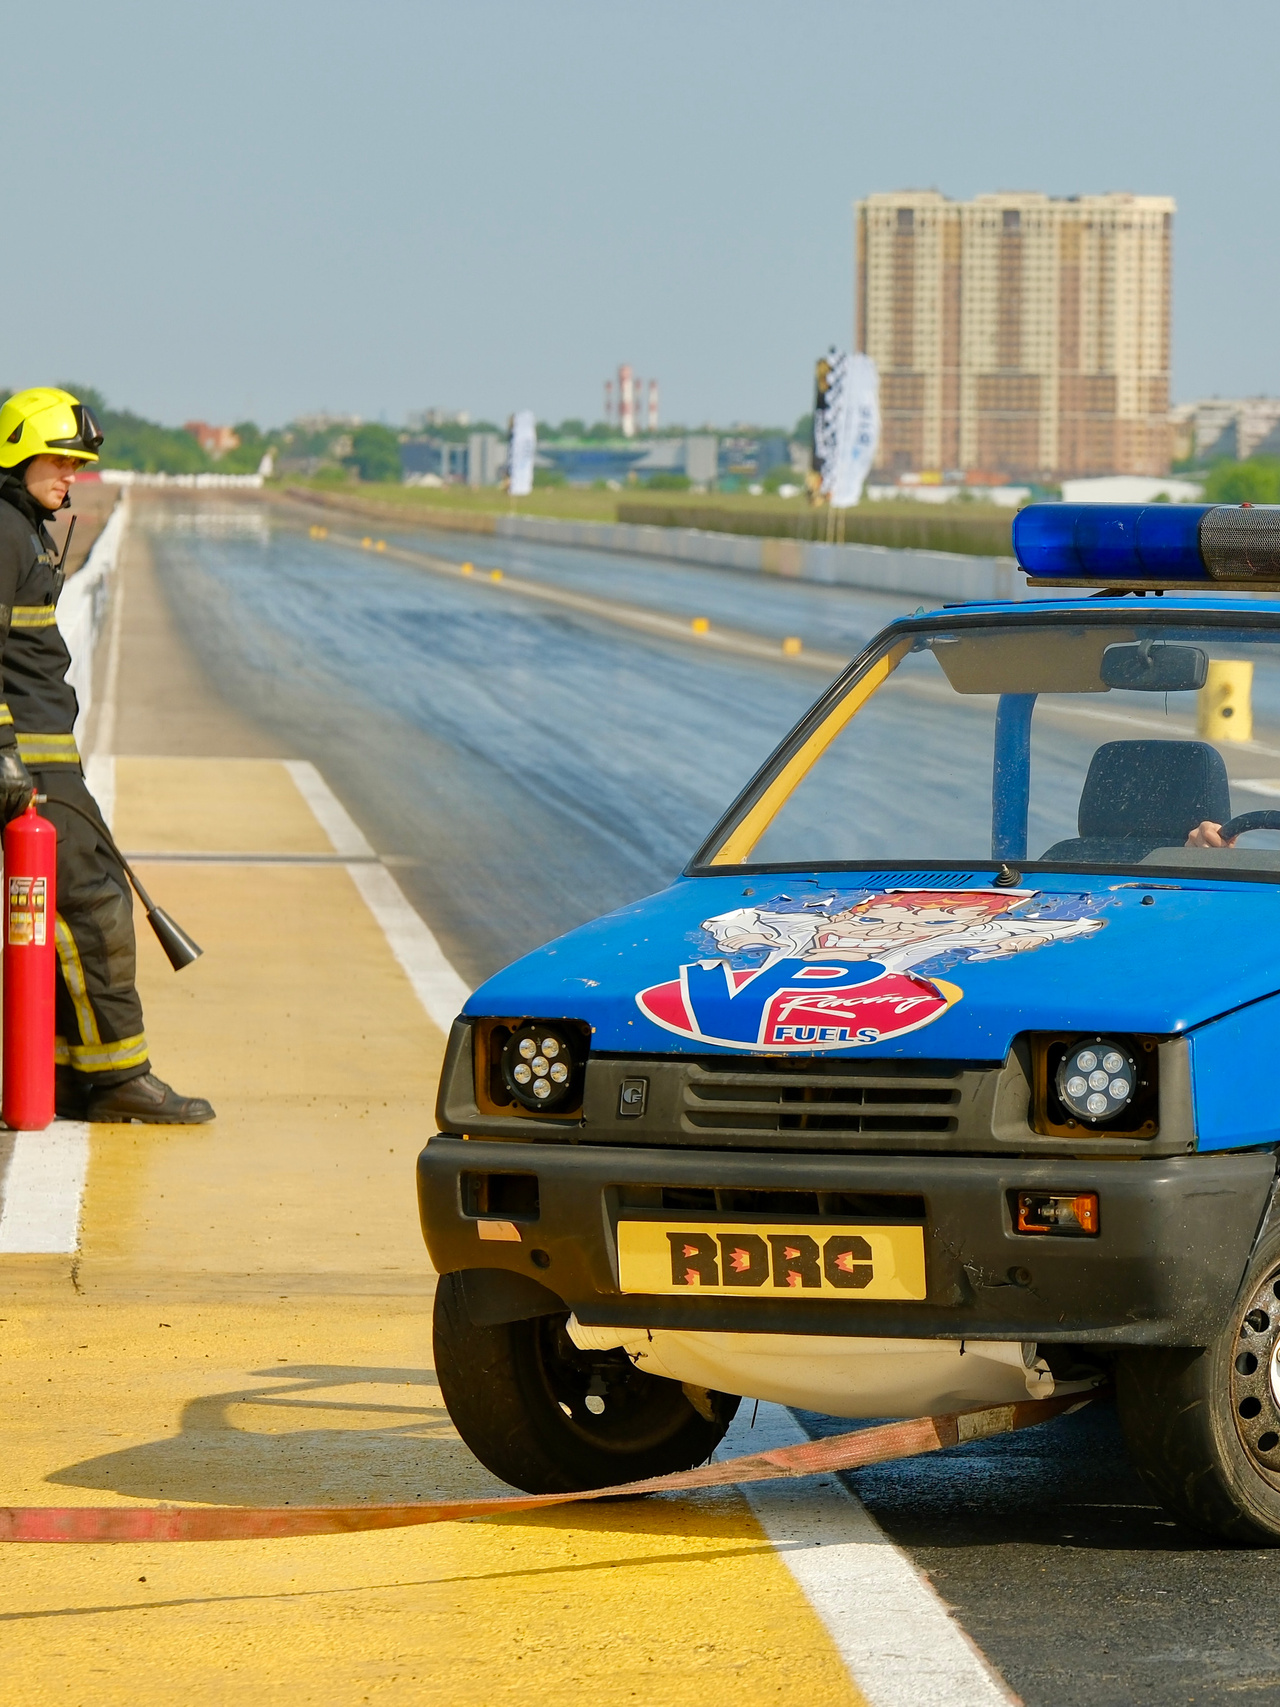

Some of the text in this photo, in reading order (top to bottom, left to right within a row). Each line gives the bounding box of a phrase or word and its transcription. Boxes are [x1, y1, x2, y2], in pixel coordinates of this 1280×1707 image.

[681, 957, 887, 1044] VP
[777, 993, 943, 1021] Racing
[773, 1025, 880, 1044] FUELS
[666, 1232, 874, 1289] RDRC
